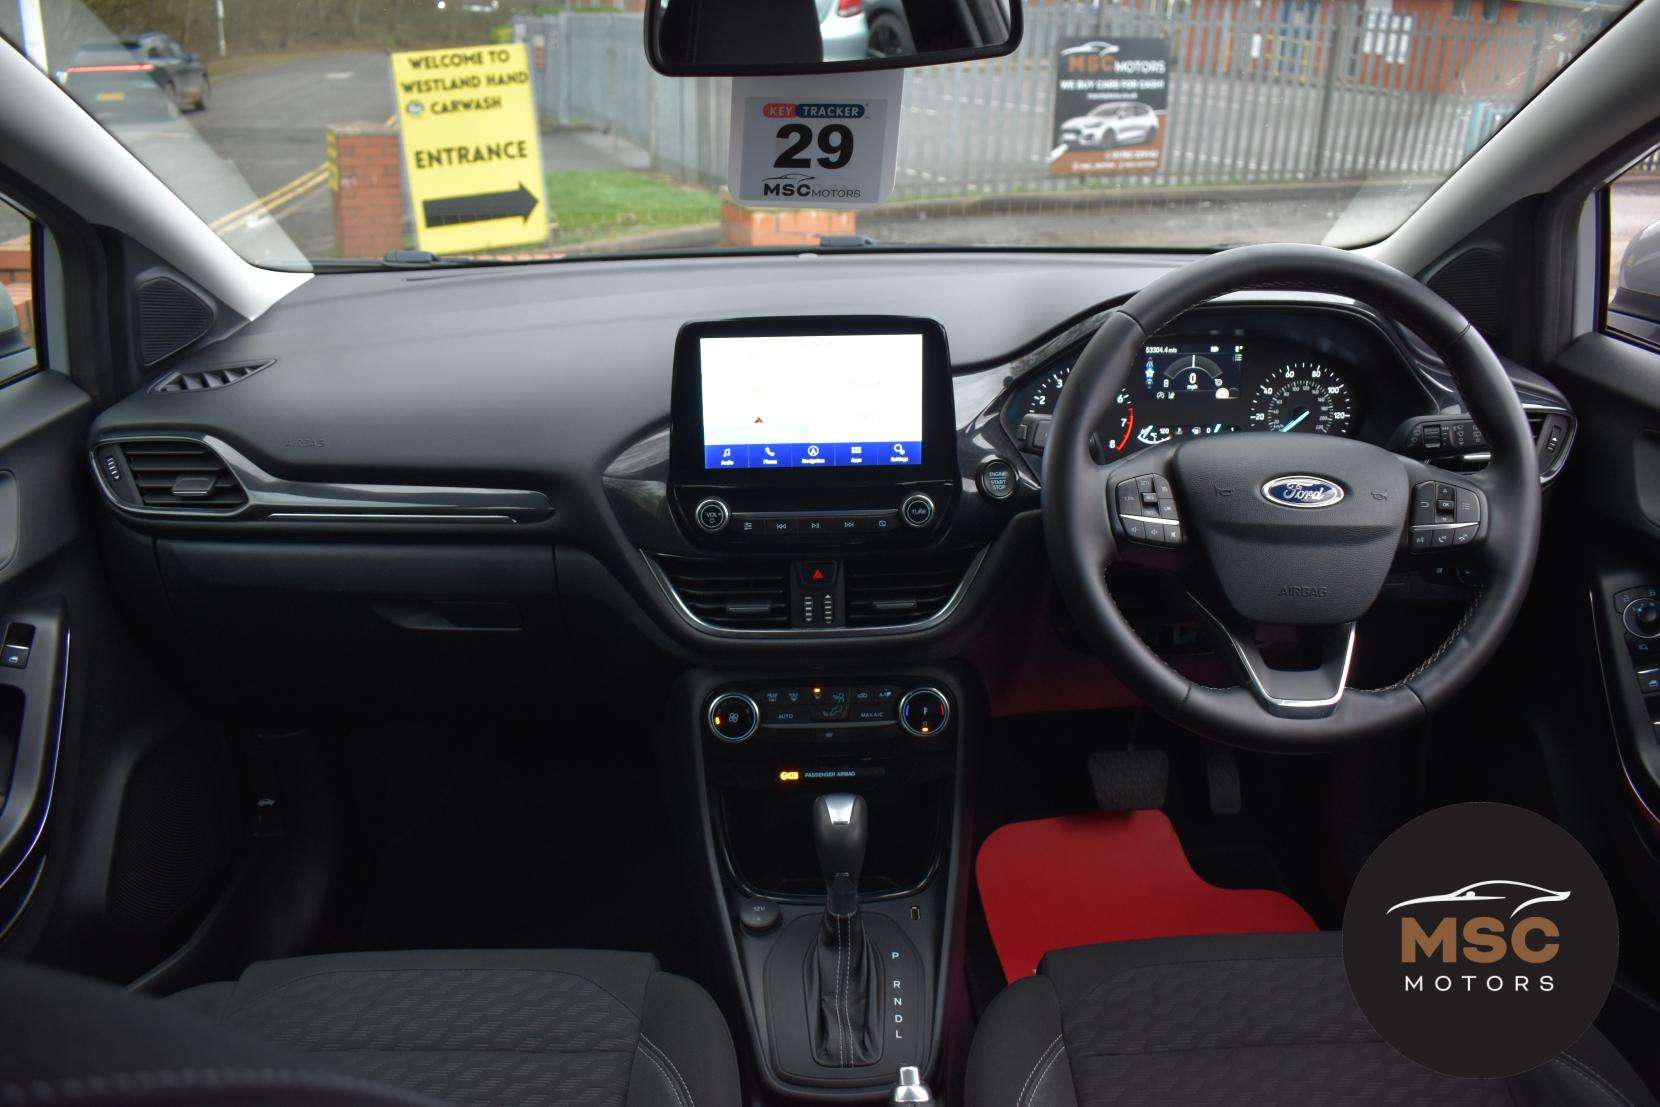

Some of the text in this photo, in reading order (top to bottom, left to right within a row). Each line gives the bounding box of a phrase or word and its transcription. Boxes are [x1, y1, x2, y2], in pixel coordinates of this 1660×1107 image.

[409, 50, 510, 69] WELCOME TO
[1067, 54, 1166, 74] MSC MOTORS
[401, 71, 529, 93] WESTLAND HAND
[431, 96, 502, 115] CARWASH
[769, 105, 860, 117] KEY TRACKER
[773, 123, 854, 170] 29
[414, 140, 528, 169] ENTRANCE
[763, 183, 861, 198] MSC MOTORS
[1056, 379, 1063, 388] 3
[1189, 372, 1197, 384] 0
[1327, 386, 1340, 394] 100
[1039, 395, 1046, 405] 2
[1117, 395, 1124, 404] 6
[1121, 418, 1127, 427] 7
[1109, 440, 1116, 448] 8
[1283, 480, 1325, 500] Ford
[1279, 585, 1328, 598] AIRBAG
[892, 952, 900, 960] P
[894, 998, 902, 1006] N
[895, 1015, 903, 1023] D
[896, 1030, 903, 1039] L
